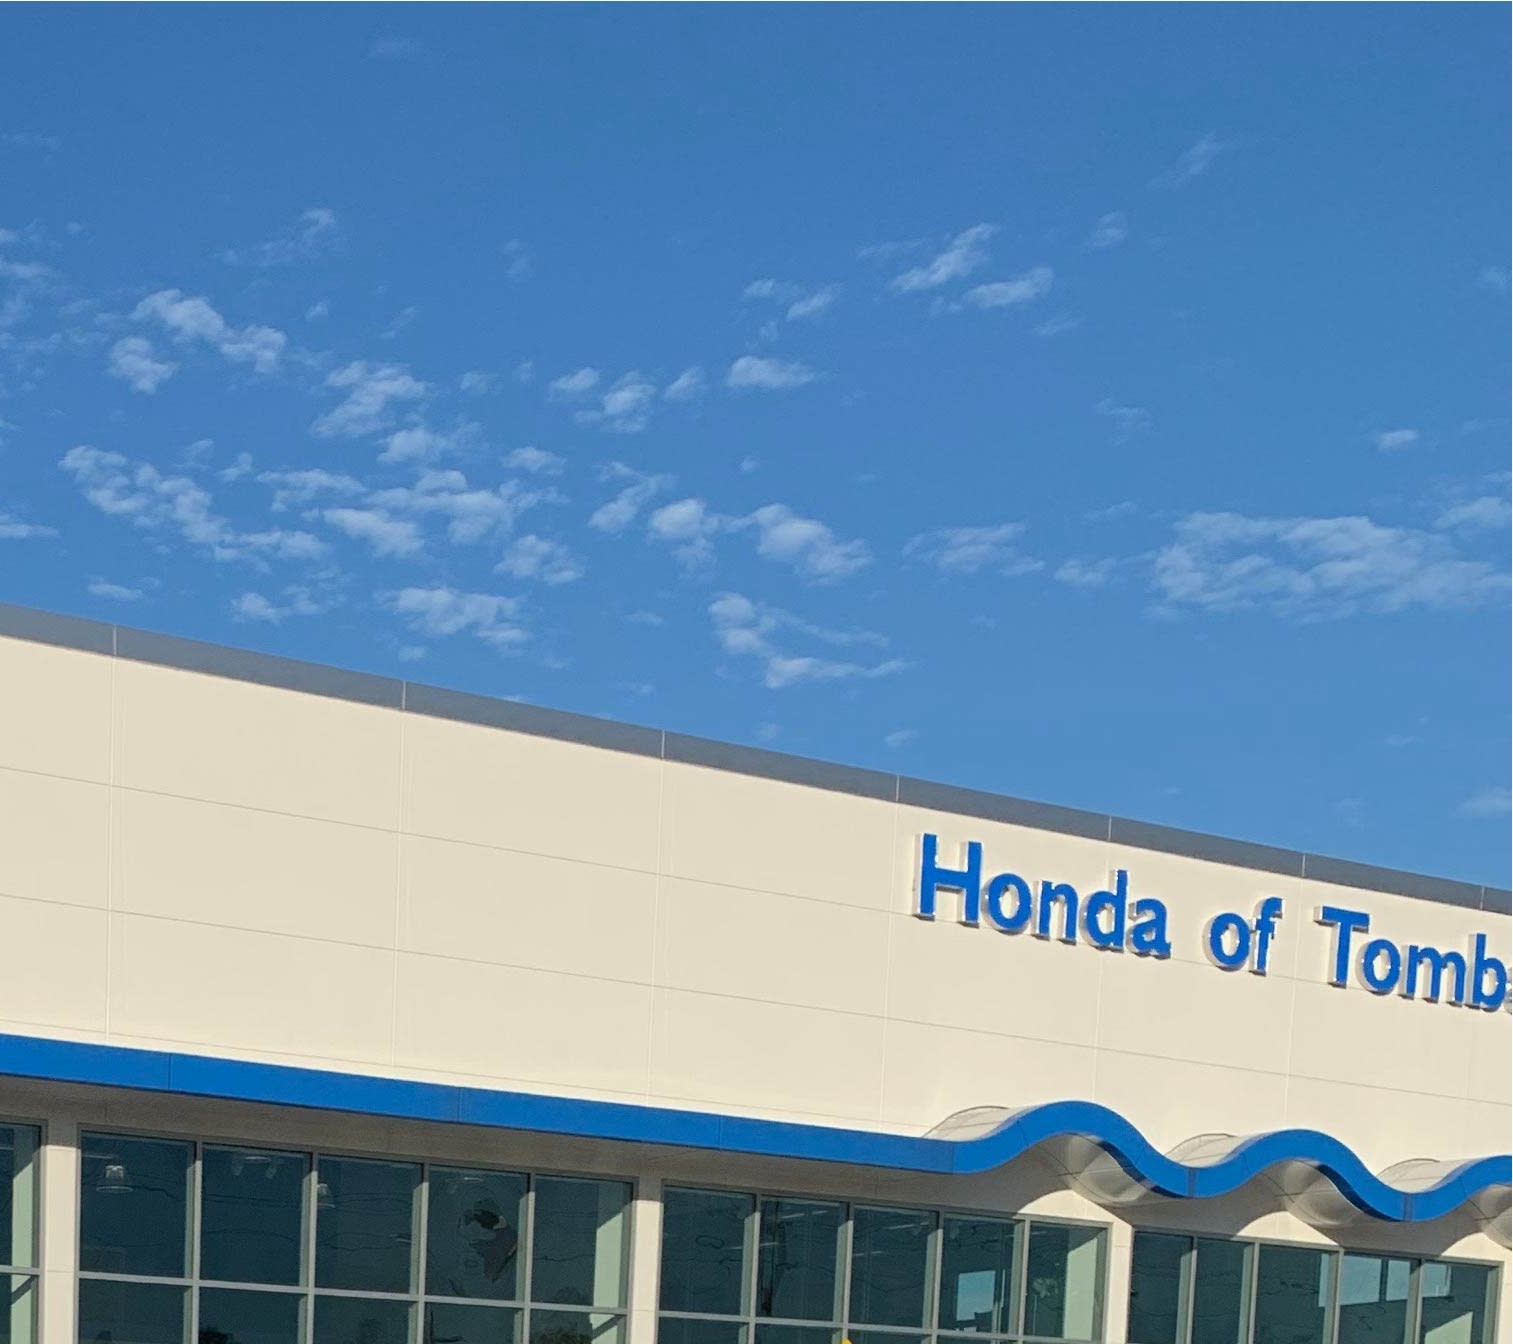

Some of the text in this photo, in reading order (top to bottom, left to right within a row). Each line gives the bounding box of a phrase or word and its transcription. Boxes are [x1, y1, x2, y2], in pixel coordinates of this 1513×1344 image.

[913, 832, 1512, 1014] Honda of Tomb
